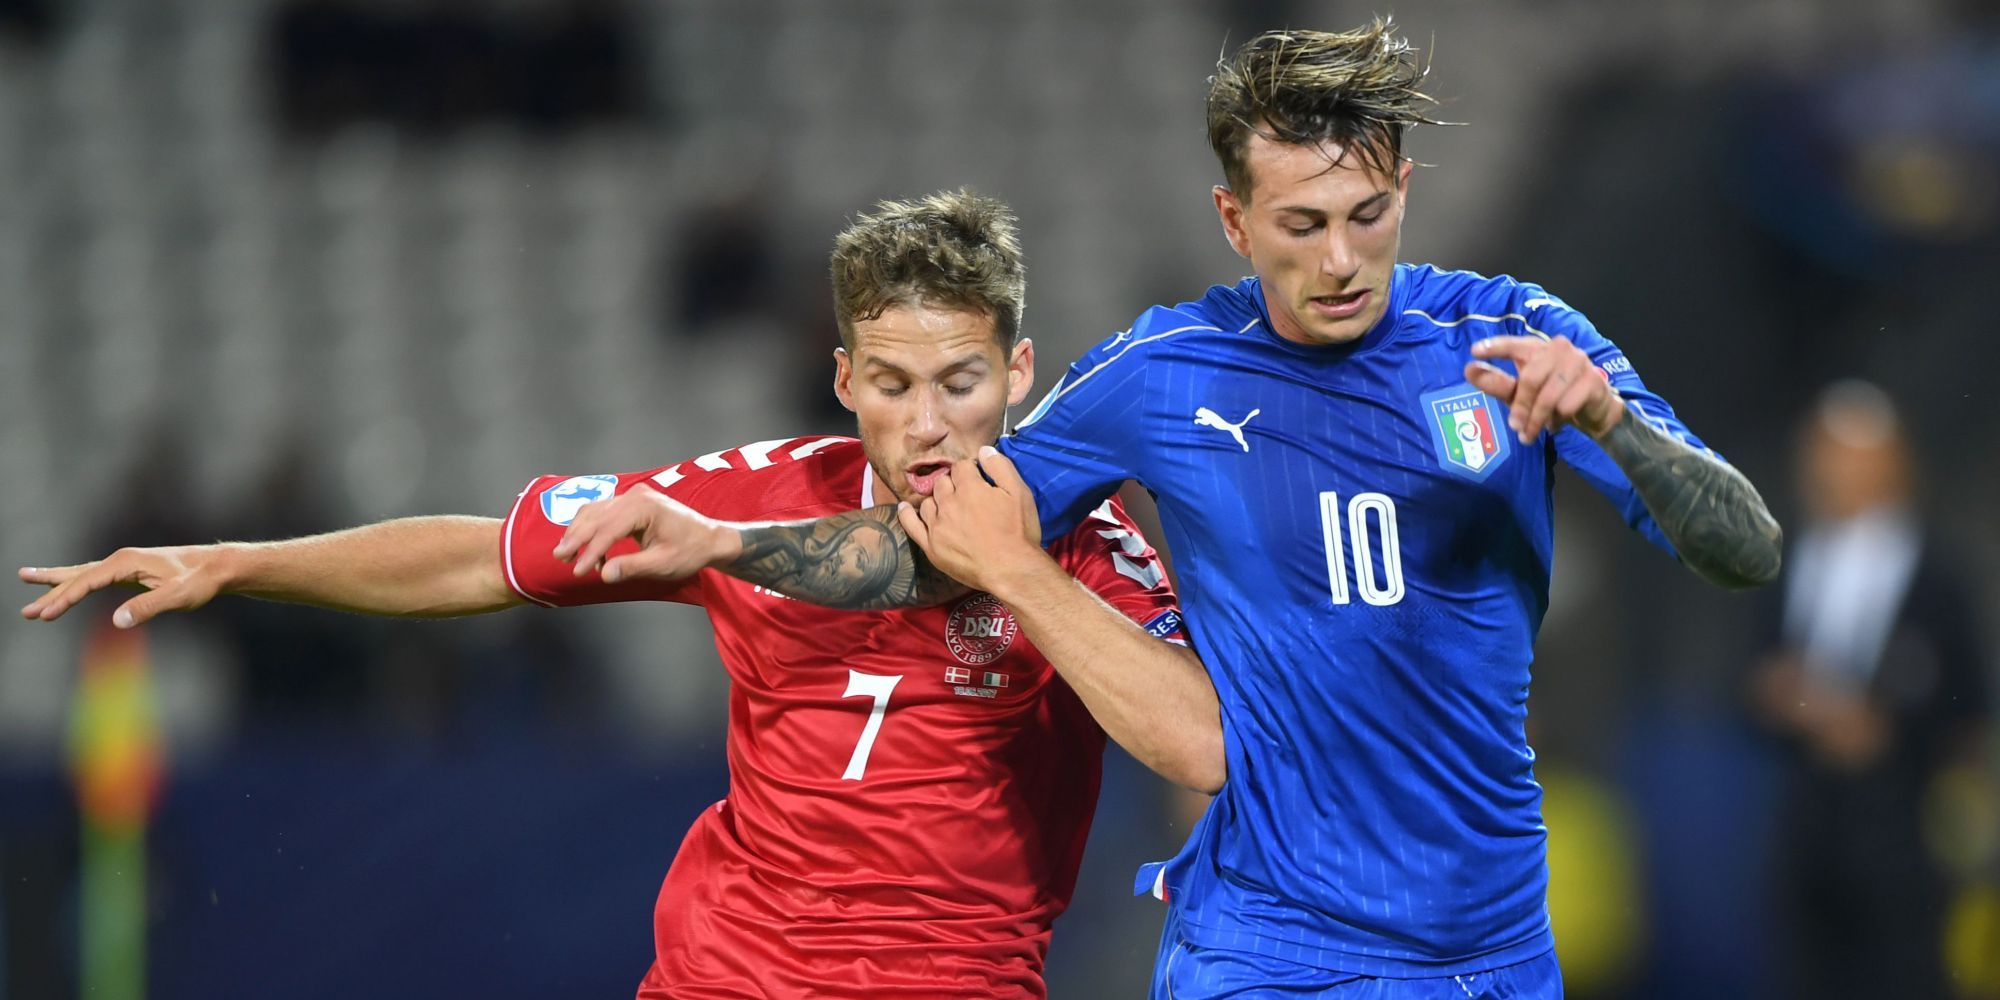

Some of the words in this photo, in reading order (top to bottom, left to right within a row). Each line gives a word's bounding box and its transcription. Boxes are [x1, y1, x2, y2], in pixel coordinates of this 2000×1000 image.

[1440, 398, 1480, 413] ITALIA
[1319, 491, 1405, 607] 10
[947, 611, 964, 654] DANSK
[961, 616, 1005, 637] DBU
[963, 652, 992, 663] 1889
[841, 668, 904, 781] 7
